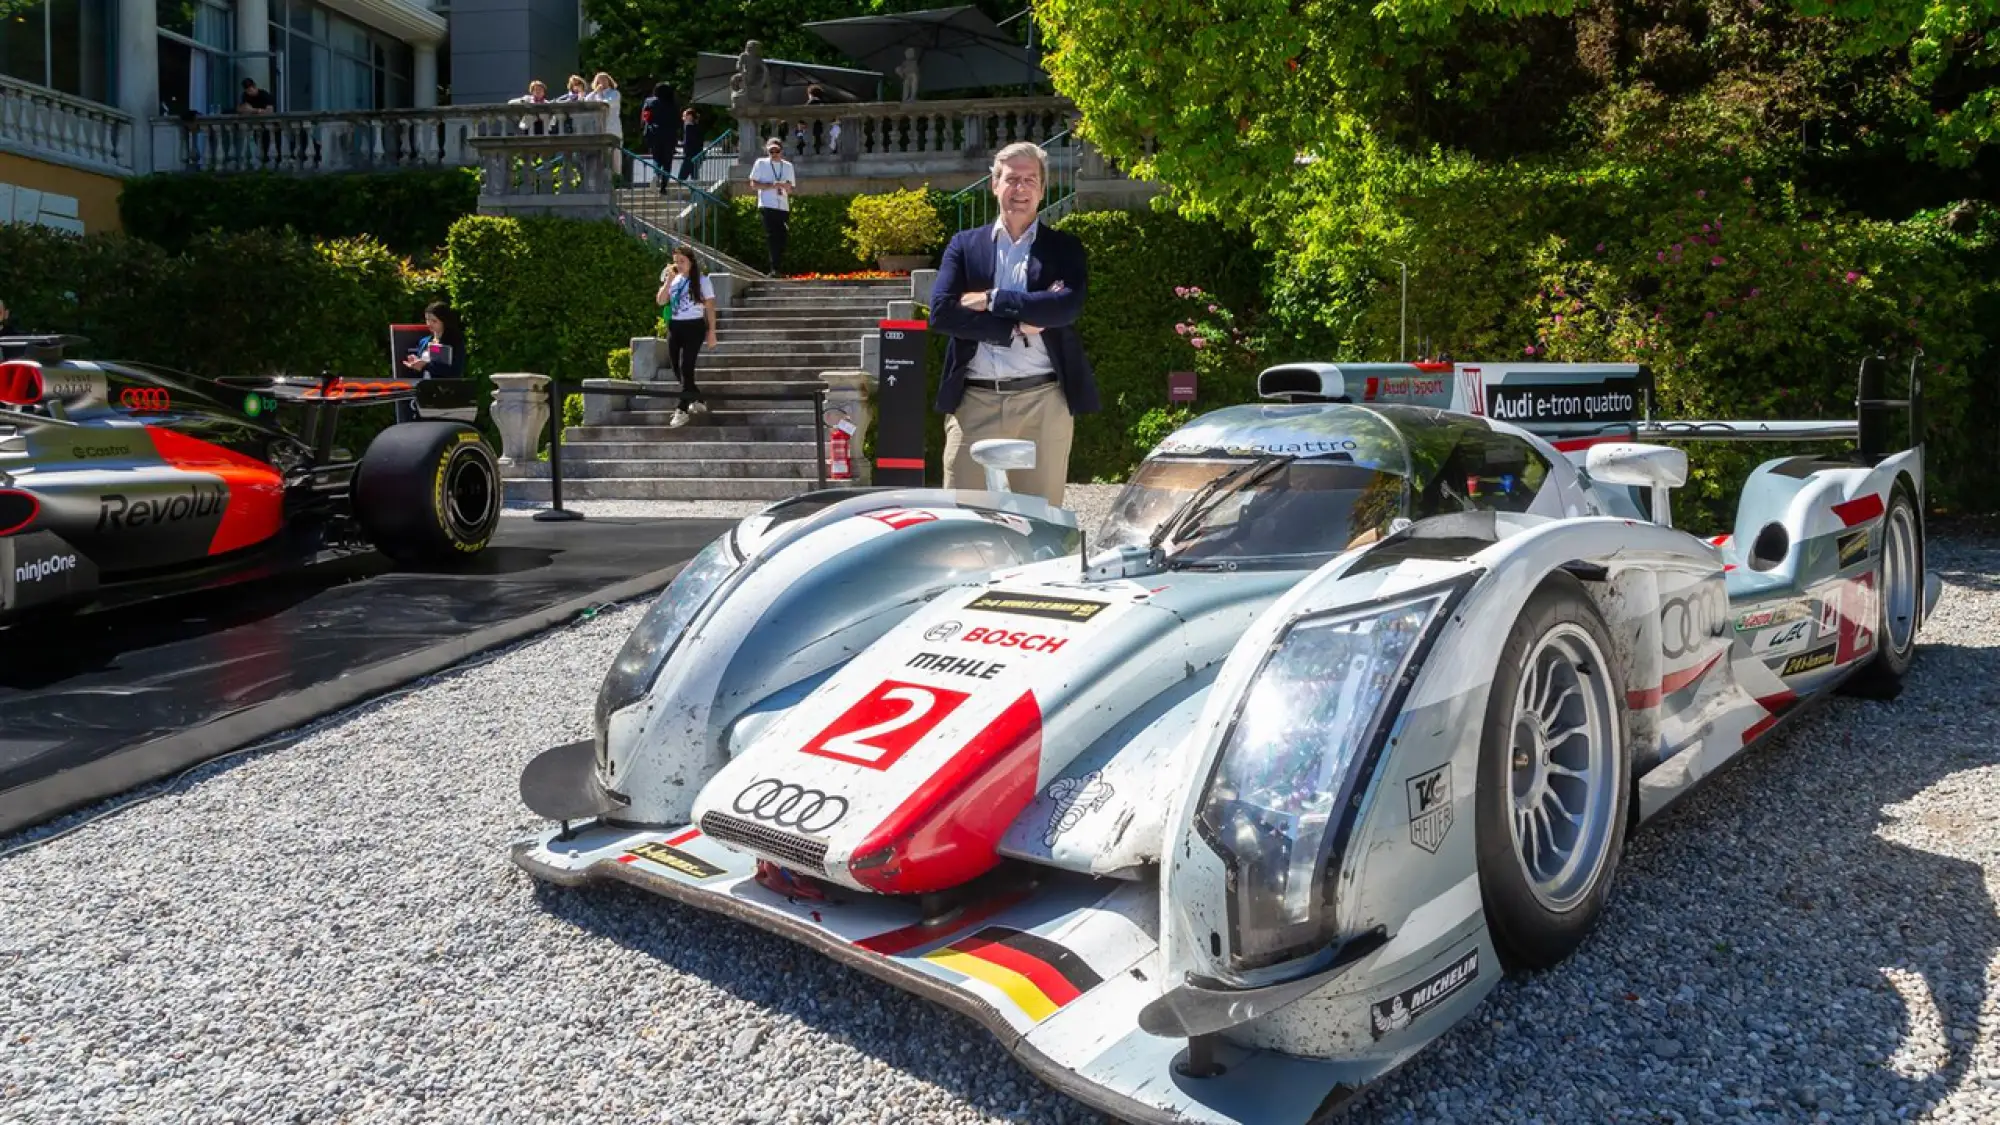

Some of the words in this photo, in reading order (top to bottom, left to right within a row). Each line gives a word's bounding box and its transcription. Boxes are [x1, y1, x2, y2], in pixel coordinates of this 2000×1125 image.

[53, 384, 92, 394] QATAR
[1384, 376, 1409, 394] Audi
[1414, 376, 1444, 396] Sport
[263, 397, 277, 412] bp
[1494, 392, 1532, 418] Audi
[1537, 394, 1581, 417] e-tron
[1584, 392, 1632, 419] quattro
[88, 444, 130, 457] Castrol
[95, 483, 230, 532] Revolut
[16, 554, 76, 582] ninjaOne
[961, 627, 1070, 654] BOSCH
[905, 652, 1007, 680] MAHLE
[819, 687, 936, 762] 2
[1415, 772, 1446, 811] TAG
[1414, 807, 1450, 848] HEUER
[1410, 953, 1477, 1010] MICHELIN
